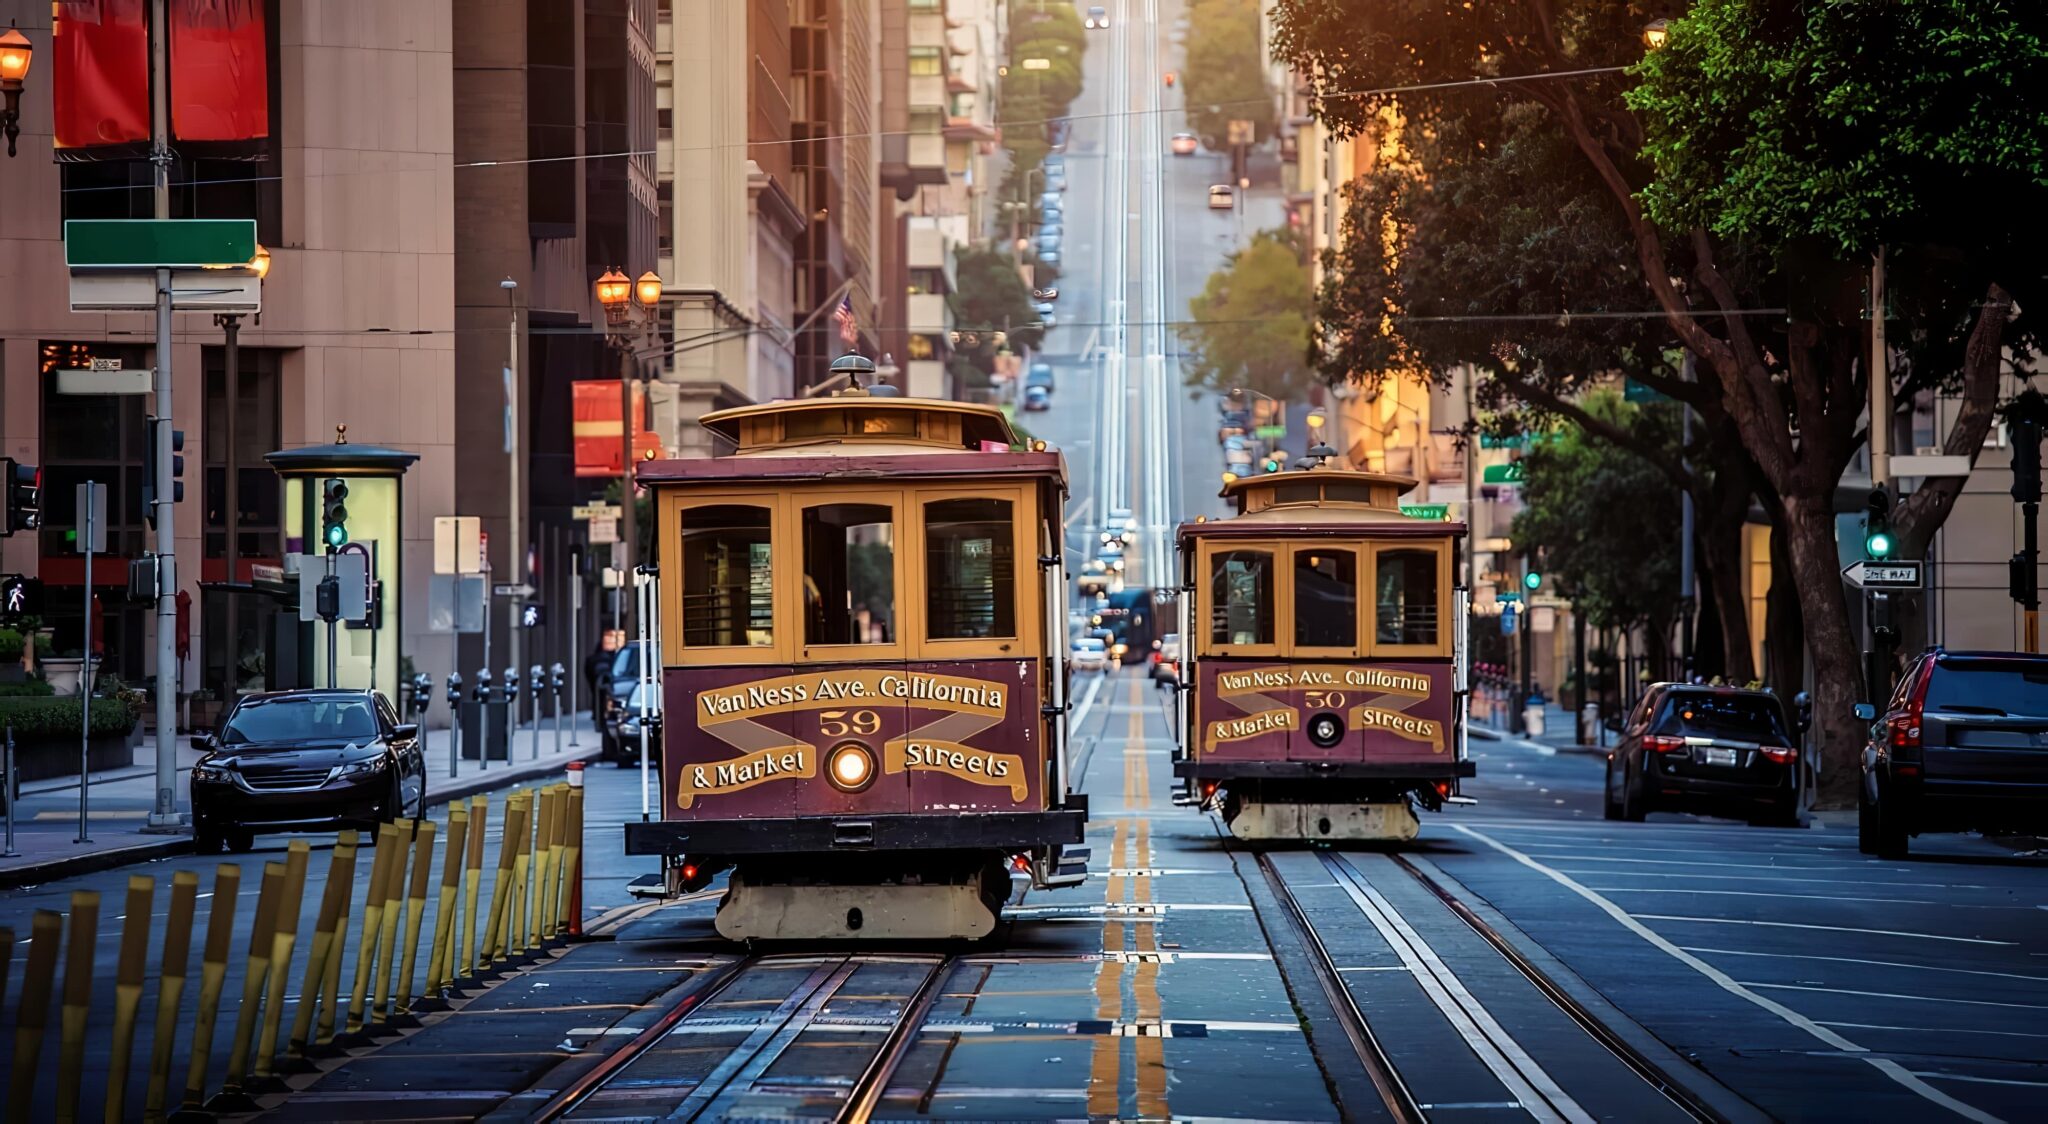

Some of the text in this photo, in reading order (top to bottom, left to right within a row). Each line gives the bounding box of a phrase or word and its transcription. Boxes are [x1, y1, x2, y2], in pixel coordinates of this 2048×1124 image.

[1889, 569, 1912, 579] WAY
[1222, 674, 1251, 690] Van
[1253, 671, 1294, 686] Ness
[1345, 670, 1428, 692] California
[701, 693, 746, 716] Van
[747, 685, 808, 708] Ness
[879, 675, 1002, 709] California
[1304, 691, 1346, 709] 50
[820, 710, 881, 737] 59
[1216, 709, 1433, 738] & Market Streets
[693, 743, 1009, 789] & Market Streets
